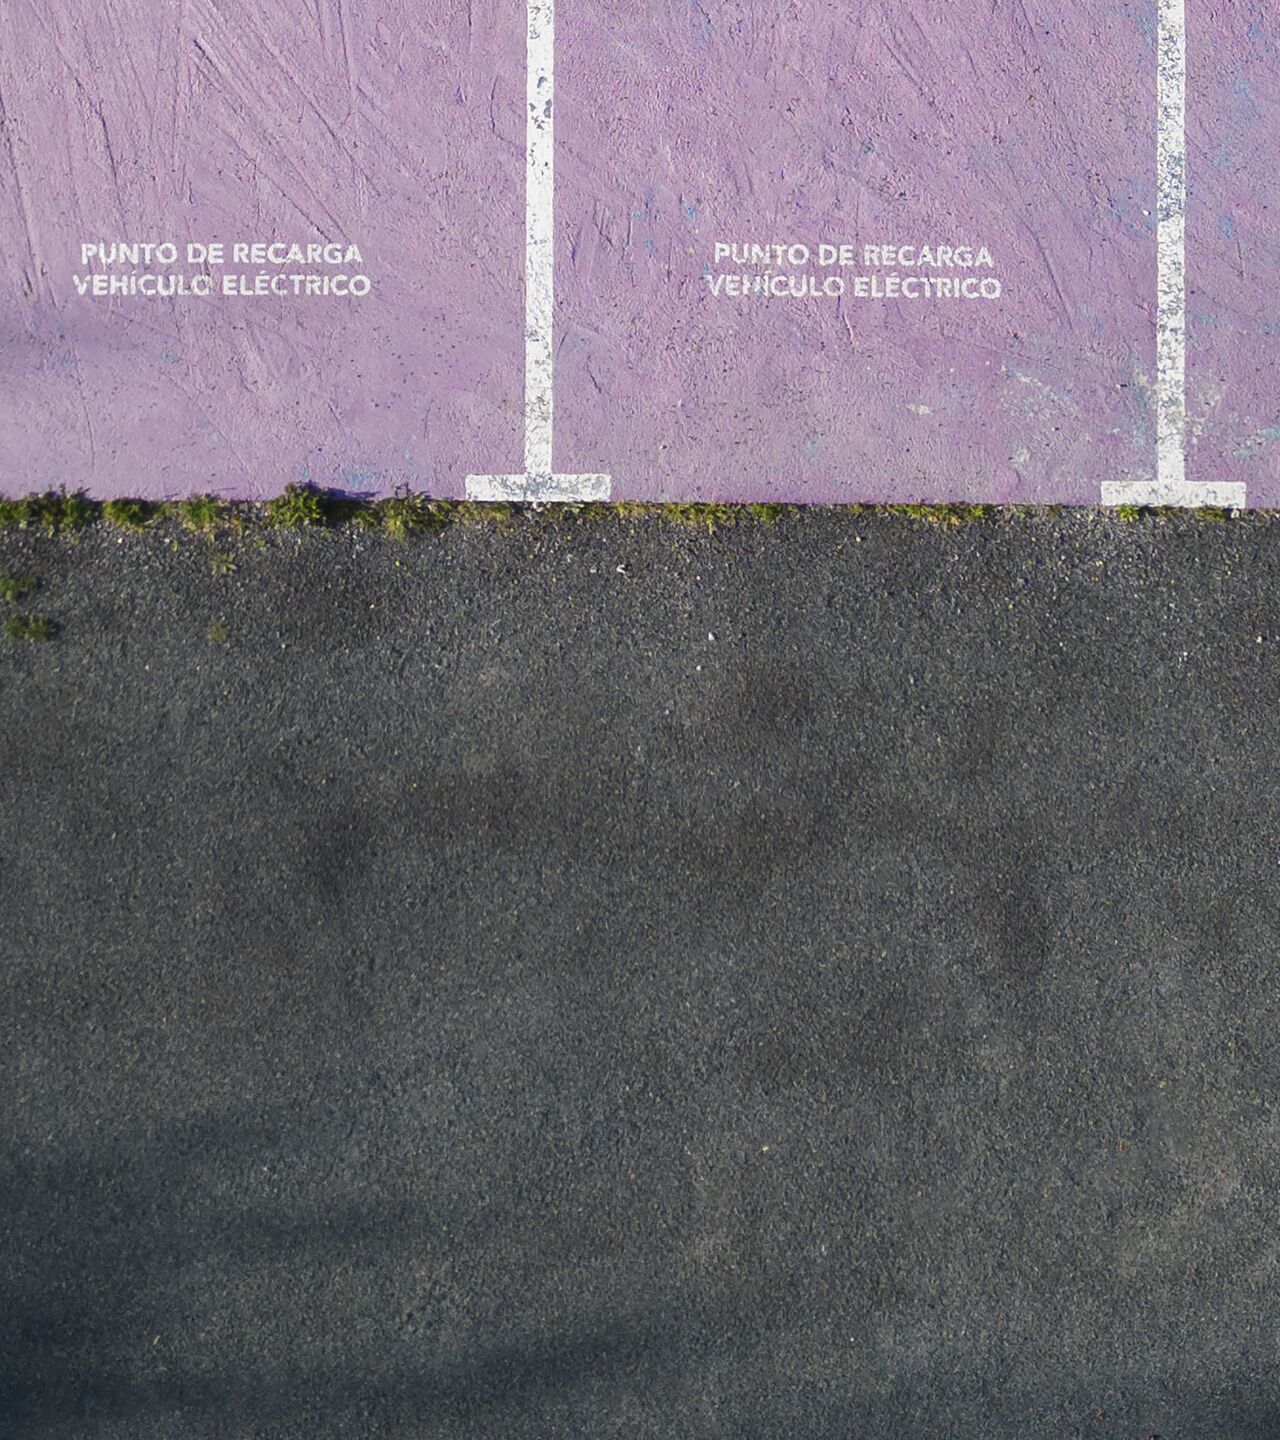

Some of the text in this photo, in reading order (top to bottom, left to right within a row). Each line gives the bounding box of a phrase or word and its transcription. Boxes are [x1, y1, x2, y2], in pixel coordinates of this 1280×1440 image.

[80, 242, 363, 265] PUNTO DE RECARGA
[714, 242, 994, 268] PUNTO DE RECARGA
[72, 270, 372, 297] VEHÍCULO ELÉCTRICO
[704, 270, 1002, 300] VEHÍCULO ELÉCTRICO
